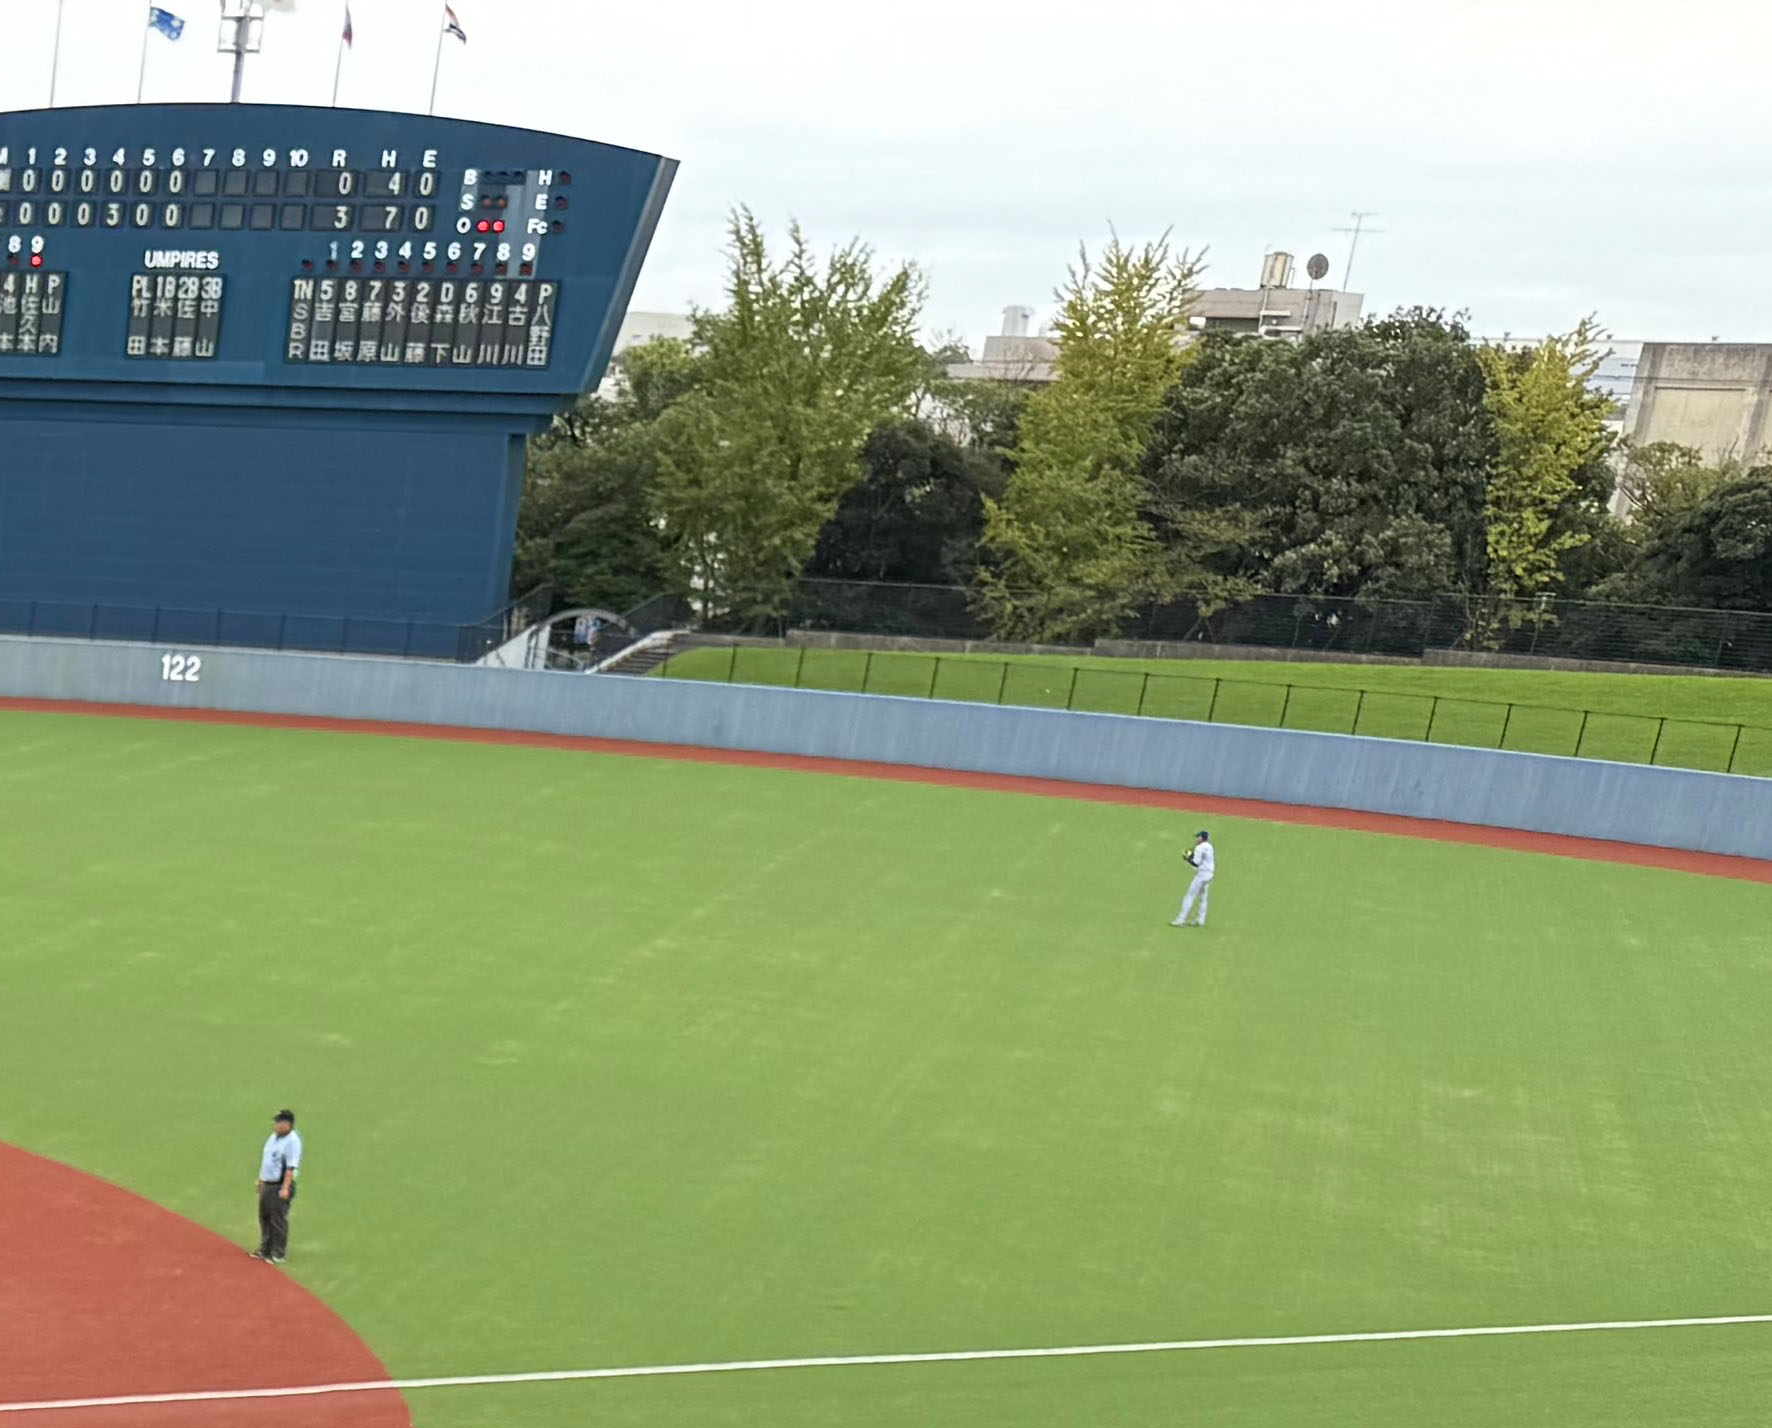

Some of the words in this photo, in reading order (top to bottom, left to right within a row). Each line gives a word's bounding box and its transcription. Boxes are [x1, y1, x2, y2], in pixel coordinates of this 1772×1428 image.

[28, 148, 36, 165] 1
[54, 148, 67, 165] 2
[84, 148, 96, 165] 3
[112, 148, 125, 165] 4
[143, 149, 155, 166] 5
[172, 148, 185, 166] 6
[203, 149, 215, 166] 7
[232, 149, 245, 167] 8
[263, 149, 276, 167] 9
[290, 149, 308, 167] 10
[333, 150, 346, 167] R
[382, 150, 396, 168] H
[423, 150, 437, 168] E
[23, 170, 34, 191] 0
[52, 170, 64, 191] 0
[81, 170, 93, 192] 0
[110, 170, 122, 192] 0
[140, 170, 152, 193] 0
[170, 170, 182, 193] 0
[339, 173, 351, 195] 0
[389, 172, 400, 195] 4
[420, 173, 433, 195] 0
[464, 169, 477, 185] B
[539, 170, 552, 186] H
[461, 194, 474, 210] S
[536, 194, 548, 210] E
[20, 203, 31, 224] 0
[48, 203, 60, 224] 0
[78, 203, 89, 225] 0
[136, 204, 148, 226] 0
[166, 204, 178, 226] 0
[335, 206, 347, 228] 3
[385, 207, 397, 229] 7
[415, 207, 427, 229] 0
[8, 235, 21, 253] 8
[31, 236, 44, 253] 9
[330, 242, 338, 260] 1
[351, 241, 364, 258] 2
[375, 241, 388, 259] 3
[399, 241, 411, 259] 4
[423, 242, 436, 260] 5
[447, 242, 461, 260] 6
[473, 243, 486, 260] 7
[496, 243, 510, 260] 8
[522, 243, 535, 261] 9
[145, 250, 219, 269] UMPIRES
[3, 275, 15, 293] 4
[26, 275, 38, 293] H
[48, 275, 60, 294] P
[132, 275, 151, 297] PL
[320, 280, 333, 300] 5
[345, 281, 357, 300] 8
[370, 281, 382, 300] 7
[393, 281, 405, 300] 3
[416, 283, 430, 301] 2
[466, 283, 478, 302] 6
[490, 284, 503, 303] 9
[515, 284, 527, 303] 4
[539, 284, 552, 304] P
[288, 304, 309, 359] SBR
[161, 653, 202, 682] 122
